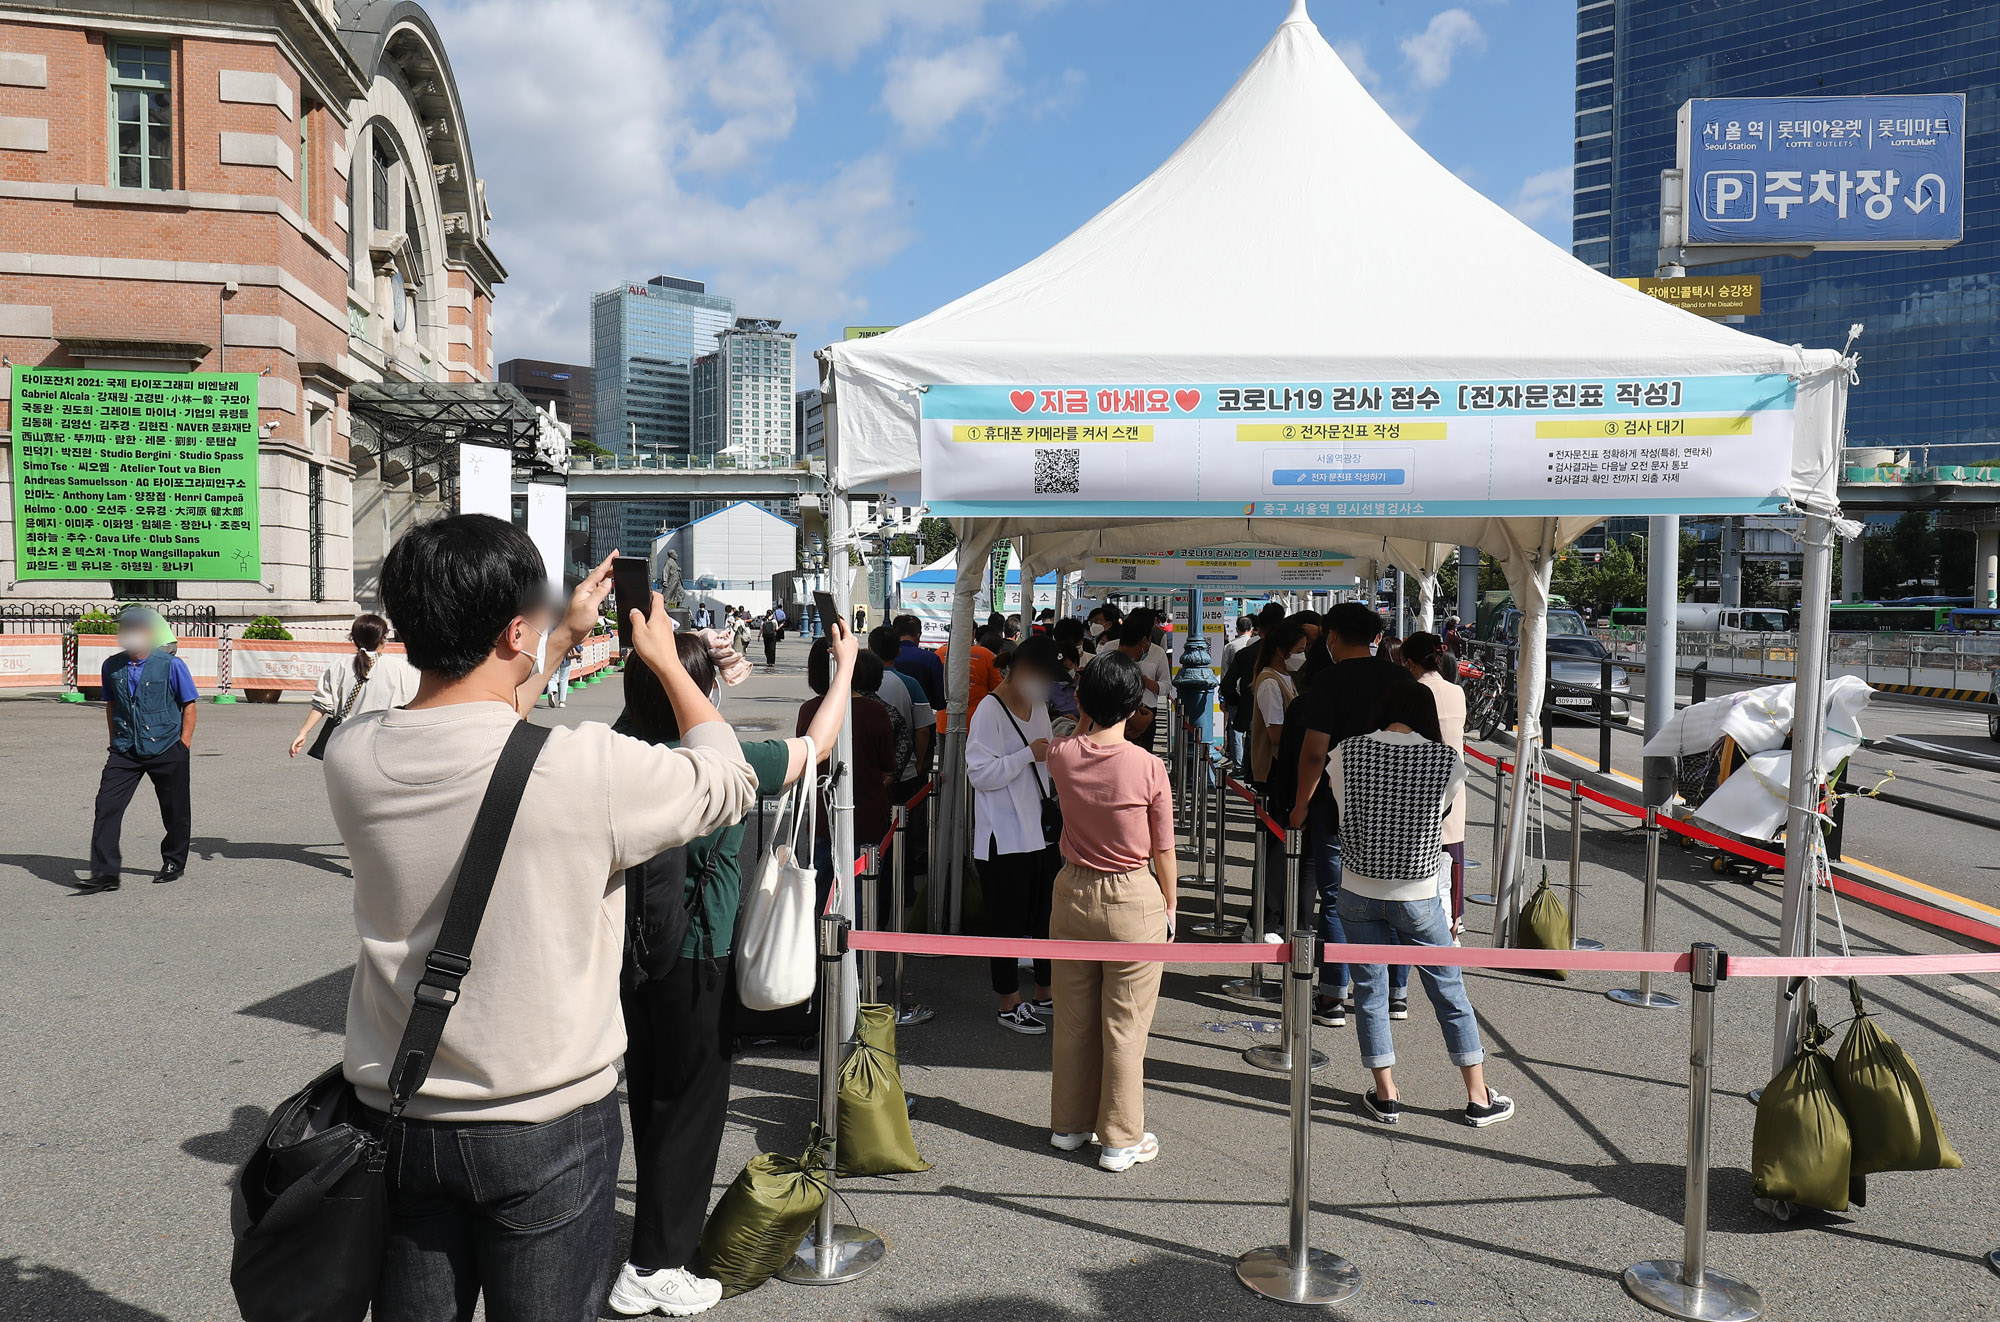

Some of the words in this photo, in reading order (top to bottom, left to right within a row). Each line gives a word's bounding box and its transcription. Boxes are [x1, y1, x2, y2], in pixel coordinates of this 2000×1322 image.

[1777, 119, 1862, 139] 롯데아울렛
[1877, 118, 1949, 138] 롯데마트
[1705, 143, 1728, 151] Seoul
[1716, 178, 1743, 214] P
[1764, 169, 1899, 220] 주차장
[629, 286, 647, 297] AIA
[1718, 284, 1753, 298] 승강장
[22, 374, 74, 386] 타이포잔치
[77, 378, 103, 387] 2021:
[107, 378, 127, 388] 국제
[131, 379, 194, 390] 타이포그래피
[198, 381, 239, 391] 비엔날레
[21, 389, 57, 399] Gabriel
[60, 391, 90, 400] Alcala
[97, 392, 128, 402] 강재원
[134, 393, 164, 403] 고경빈
[220, 395, 250, 404] 구모아
[1040, 390, 1088, 413] 지금
[1097, 389, 1171, 413] 하세요
[1218, 388, 1322, 411] 코로나19
[1333, 387, 1382, 410] 검사
[1391, 387, 1440, 410] 접수
[1458, 384, 1604, 410] [전자문진표
[1616, 382, 1681, 407] 작성]
[21, 402, 53, 413] 국동완
[100, 406, 142, 416] 그레이트
[146, 407, 177, 417] 마이너
[184, 408, 215, 418] 기업의
[61, 419, 91, 429] 김영선
[100, 420, 130, 430] 김주경
[138, 421, 168, 432] 김현진
[176, 423, 209, 432] NAVER
[212, 422, 252, 432] 문화재단
[1300, 425, 1369, 440] 전자문진표
[1373, 424, 1400, 439] 작성
[1624, 420, 1652, 435] 검사
[1656, 419, 1684, 435] 대기
[984, 427, 1023, 441] 휴대폰
[1027, 427, 1078, 441] 카메라를
[1082, 427, 1108, 441] 켜서
[1112, 427, 1139, 440] 스캔
[23, 446, 53, 457] 민덕기
[61, 447, 92, 458] 박진현
[100, 449, 133, 458] Studio
[135, 450, 171, 461] Bergini
[179, 451, 212, 460] Studio
[214, 452, 244, 462] Spass
[1317, 454, 1361, 464] 서울역광장
[1555, 450, 1599, 460] 전자문진표
[1602, 449, 1637, 459] 정확하게
[1640, 448, 1680, 459] 작성(특히,
[1684, 447, 1713, 458] 연락처)
[23, 461, 49, 471] Simo
[50, 462, 68, 471] Tse
[120, 464, 156, 473] Atelier
[158, 464, 181, 473] Tout
[198, 465, 221, 474] Bien
[1555, 462, 1598, 473] 검사결과는
[1601, 461, 1627, 472] 다음날
[1630, 461, 1648, 471] 오전
[1651, 461, 1669, 471] 문자
[1671, 461, 1689, 470] 통보
[24, 475, 66, 485] Andreas
[68, 477, 128, 486] Samuelsson
[136, 478, 150, 487] AG
[153, 478, 247, 488] 타이포그라피연구소
[1311, 473, 1327, 482] 전자
[1329, 473, 1352, 482] 문진표
[1354, 472, 1386, 482] 작성하기
[1554, 475, 1589, 485] 검사결과
[1591, 474, 1609, 484] 확인
[1612, 474, 1639, 484] 전까지
[1641, 473, 1659, 483] 외출
[1662, 473, 1680, 483] 자제
[24, 489, 55, 500] 안마노
[62, 490, 104, 502] Anthony
[106, 491, 127, 500] Lam
[174, 493, 202, 502] Henri
[24, 504, 56, 514] Helmo
[64, 505, 88, 514] 0.00
[96, 505, 127, 515] 오선주
[135, 505, 167, 515] 오유경
[1263, 503, 1288, 516] 중구
[1293, 503, 1330, 516] 서울역
[1336, 503, 1425, 515] 임시선별검사소
[64, 518, 95, 528] 이미주
[102, 519, 134, 530] 이화영
[180, 520, 212, 530] 장한나
[220, 520, 251, 531] 조준익
[66, 532, 87, 543] 추수
[95, 533, 120, 543] Cava
[121, 533, 141, 543] Life
[149, 534, 173, 543] Club
[174, 534, 200, 543] Sans
[113, 547, 138, 559] Tnop
[140, 548, 221, 560] Wangsillapakun
[1180, 549, 1212, 557] 코로나19
[1216, 549, 1231, 558] 검사
[1234, 549, 1249, 558] 접수
[26, 560, 59, 571] 파일드
[81, 560, 113, 571] 유니온
